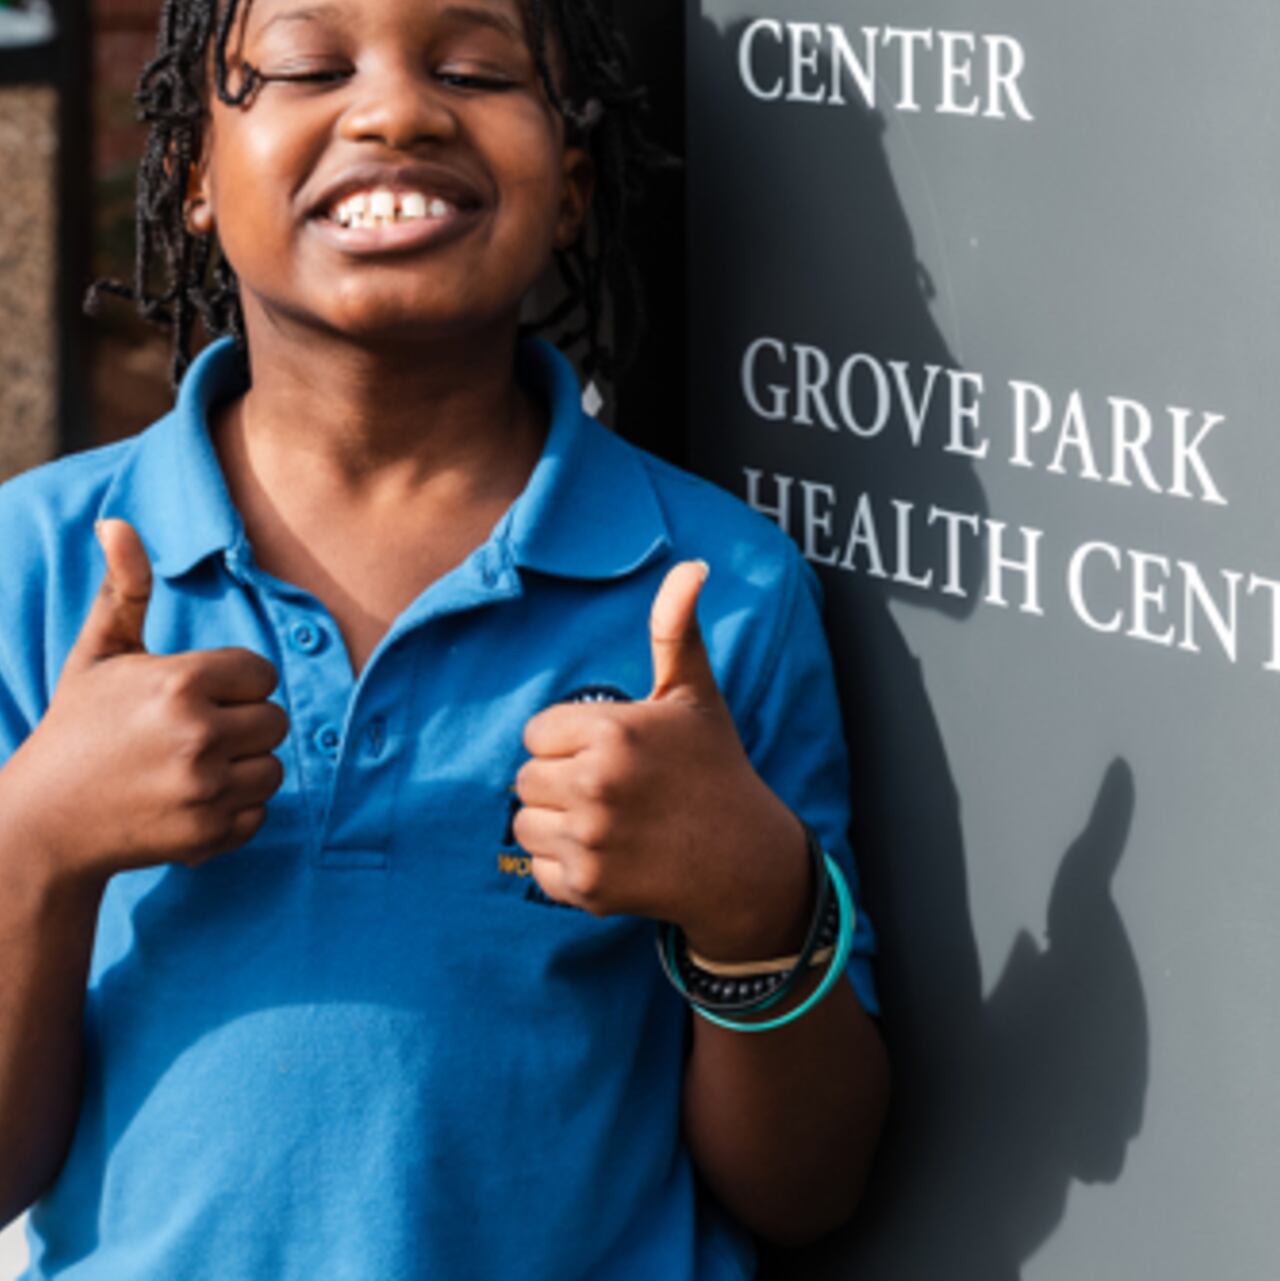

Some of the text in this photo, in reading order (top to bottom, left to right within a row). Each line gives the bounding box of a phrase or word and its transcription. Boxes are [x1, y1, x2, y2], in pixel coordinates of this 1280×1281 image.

[737, 18, 1035, 122] CENTER
[741, 336, 1229, 506] GROVE PARK
[743, 465, 1045, 616] HEALTH
